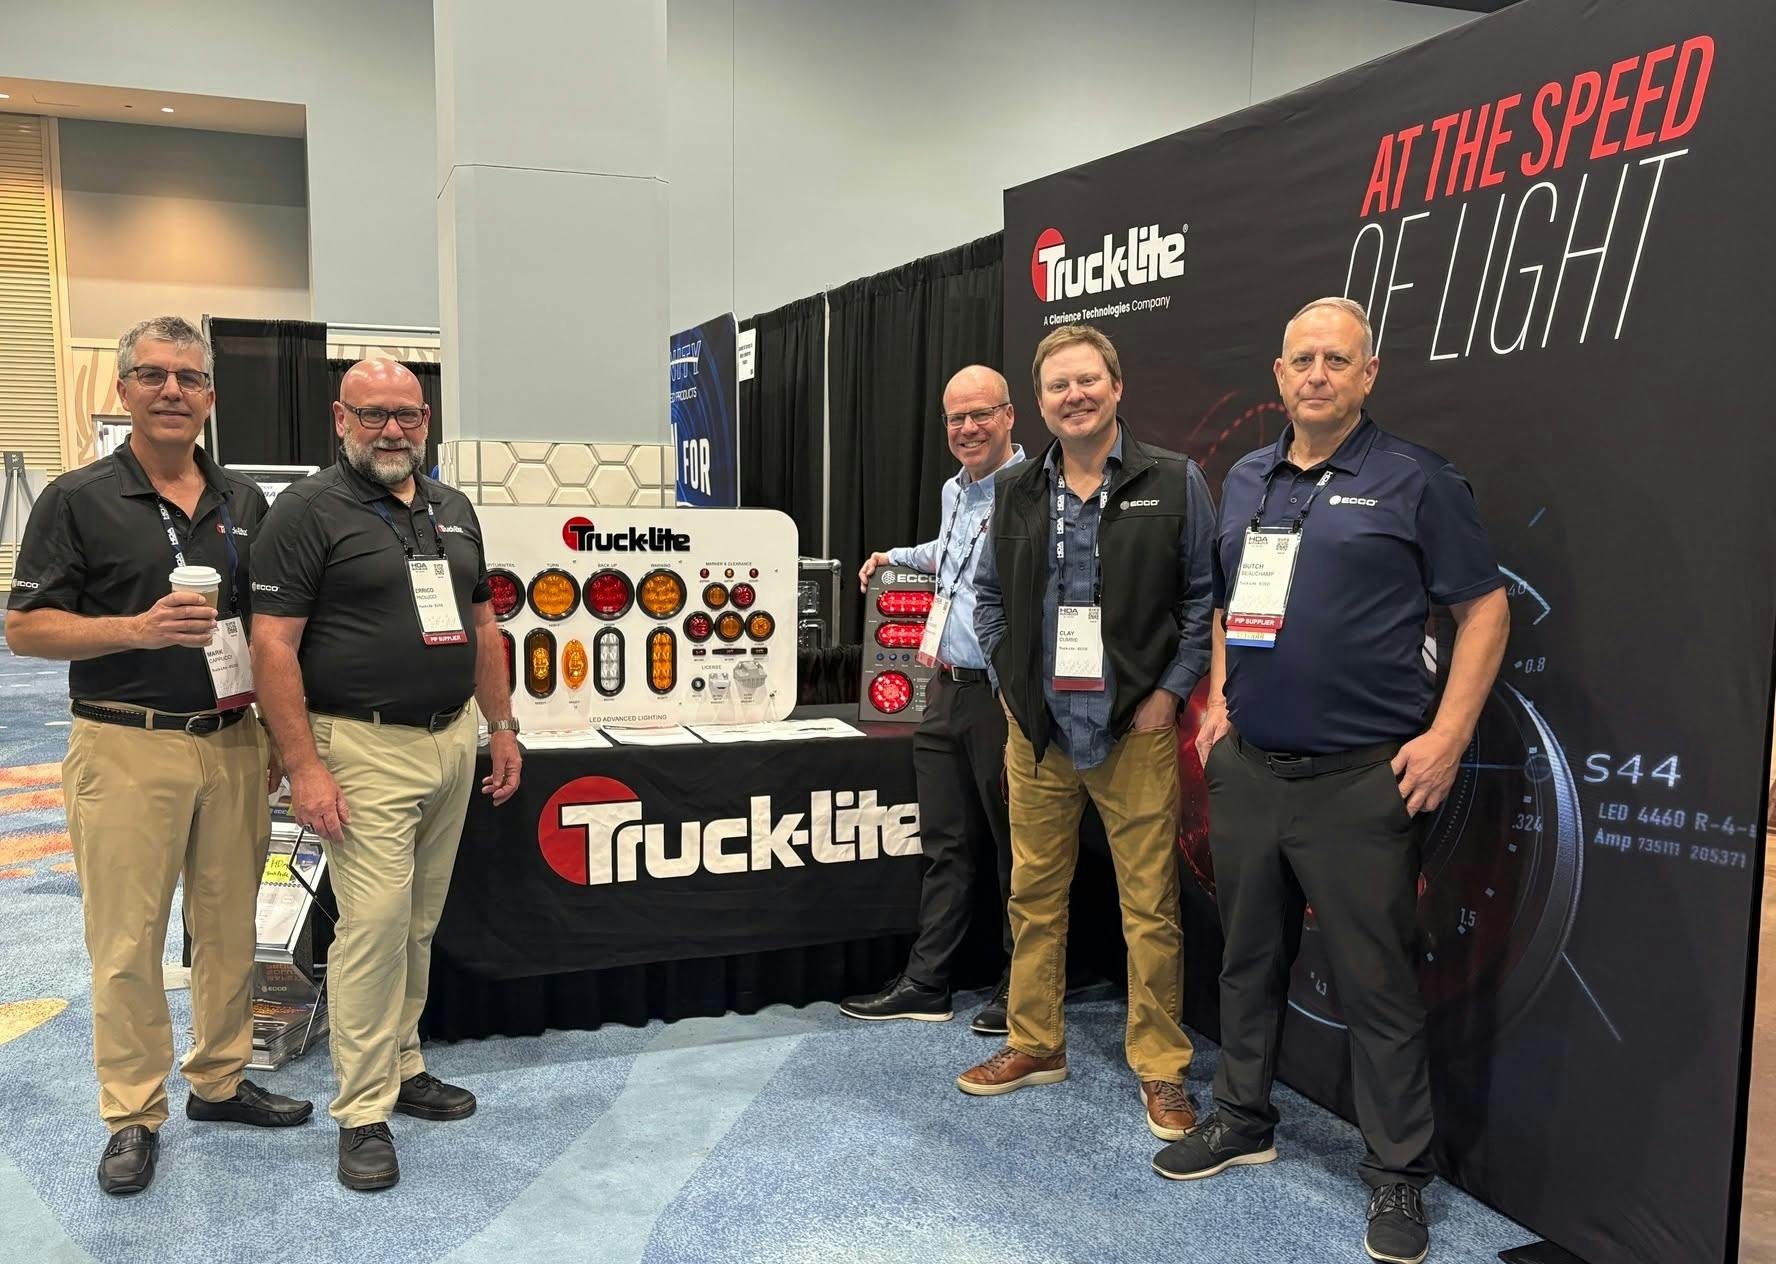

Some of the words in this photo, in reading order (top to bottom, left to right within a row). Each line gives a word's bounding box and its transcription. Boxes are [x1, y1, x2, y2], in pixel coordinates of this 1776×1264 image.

[1360, 124, 1424, 217] AT
[1425, 93, 1522, 202] THE
[1520, 35, 1715, 176] SPEED
[1344, 212, 1431, 357] OF
[1430, 148, 1689, 360] LIGHT
[1043, 316, 1049, 326] A
[1049, 310, 1081, 326] Clarience
[1082, 301, 1130, 318] Technologies
[1131, 295, 1171, 312] Company
[683, 438, 711, 496] FOR
[1341, 497, 1376, 506] ECCO
[569, 524, 691, 552] Truck-Lite
[1245, 618, 1275, 626] SUPPLIER
[206, 649, 223, 657] MARK
[1525, 656, 1546, 673] 0.8
[1583, 753, 1681, 787] S44
[1598, 802, 1629, 822] LED
[1637, 806, 1686, 828] 4460
[562, 789, 924, 886] Truck-Lite
[1593, 827, 1632, 853] Amp
[1460, 907, 1477, 927] 1.5
